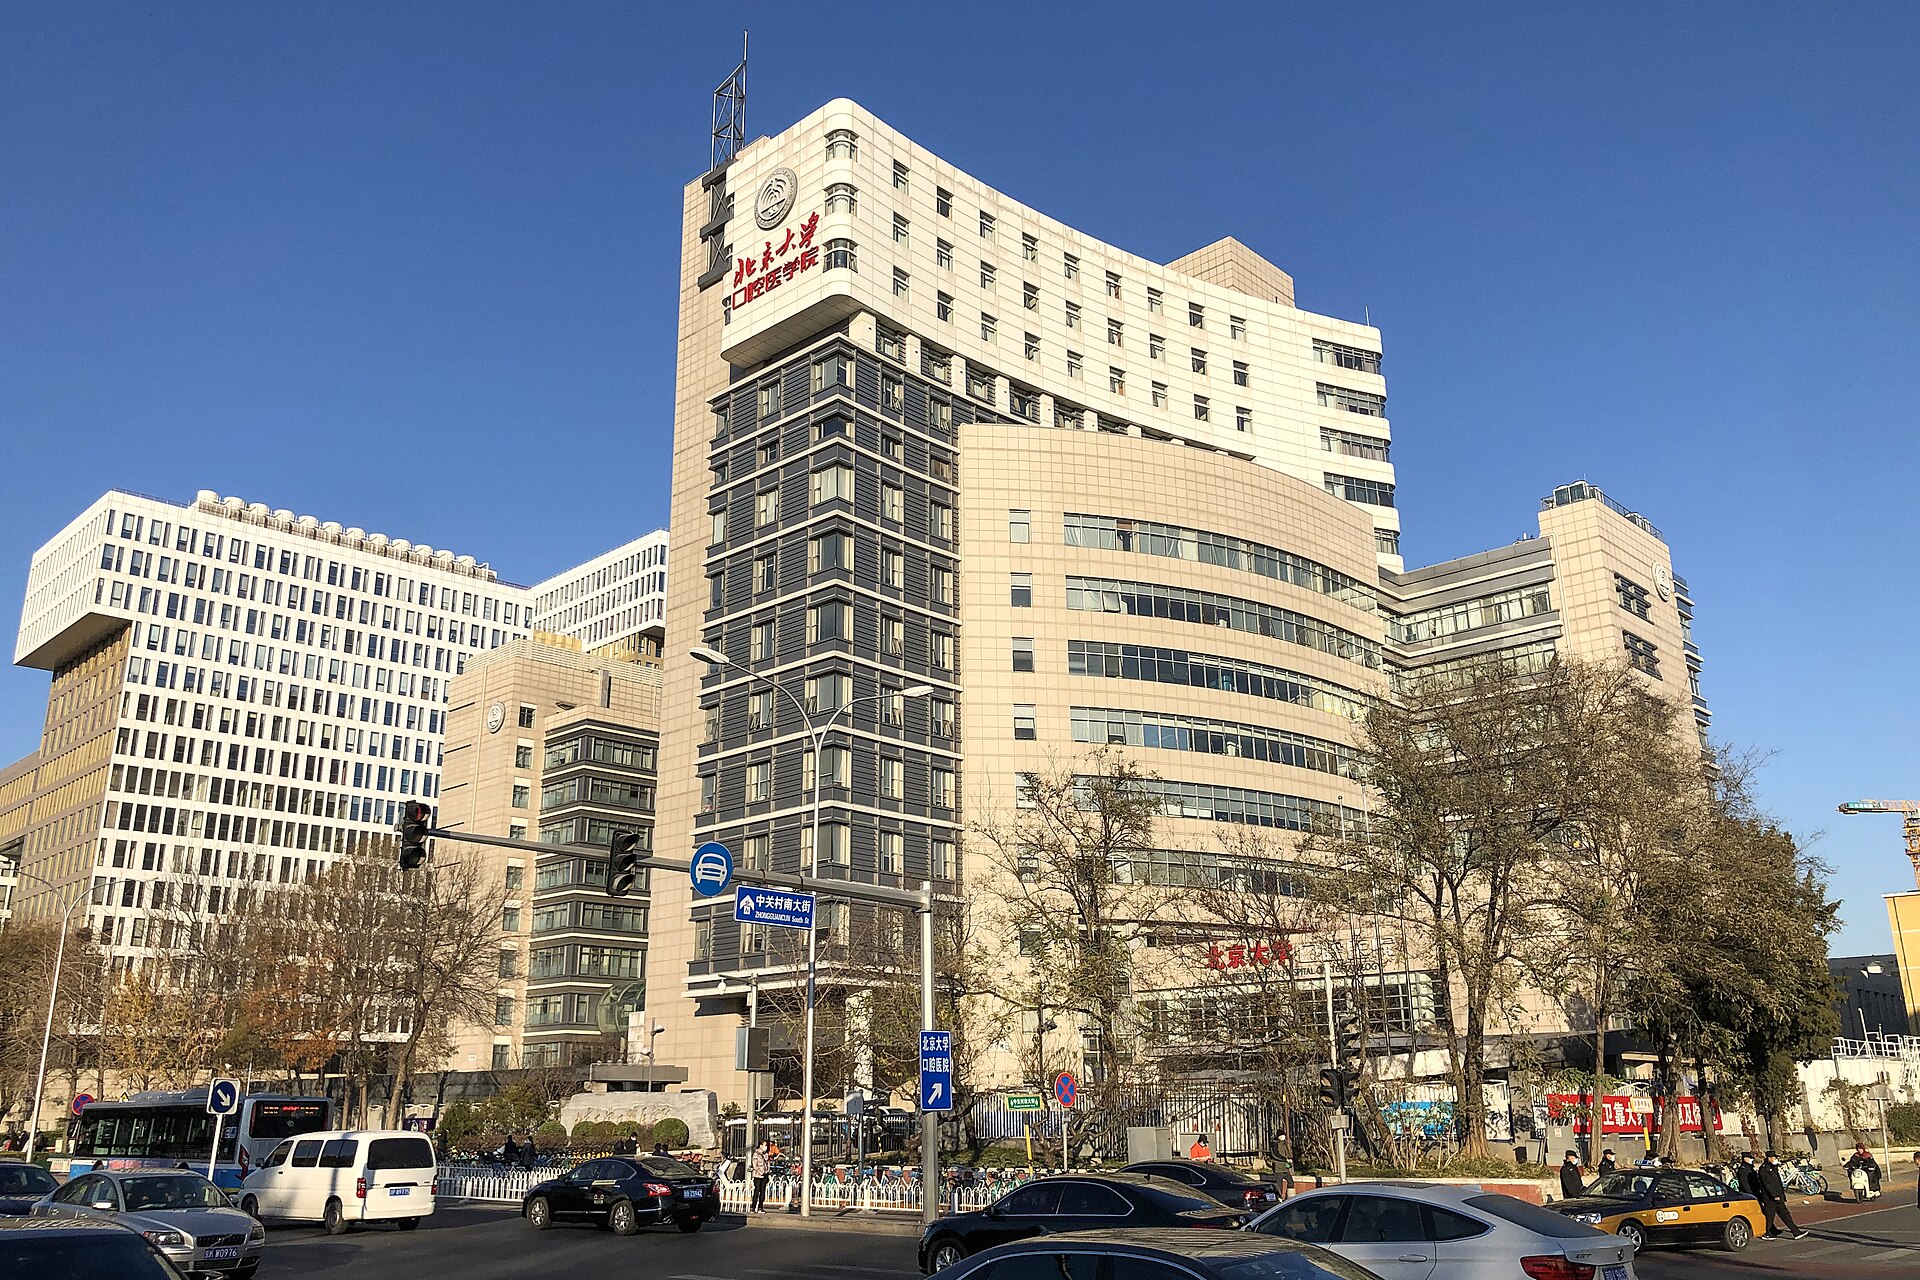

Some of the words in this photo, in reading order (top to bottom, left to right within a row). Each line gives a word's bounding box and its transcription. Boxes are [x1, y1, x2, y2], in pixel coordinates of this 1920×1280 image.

[733, 211, 820, 288] 北京大学
[732, 246, 820, 310] 口腔医学院
[755, 893, 811, 914] 中关村南大街
[922, 1035, 949, 1052] 北京大学
[922, 1056, 950, 1073] 口腔医院
